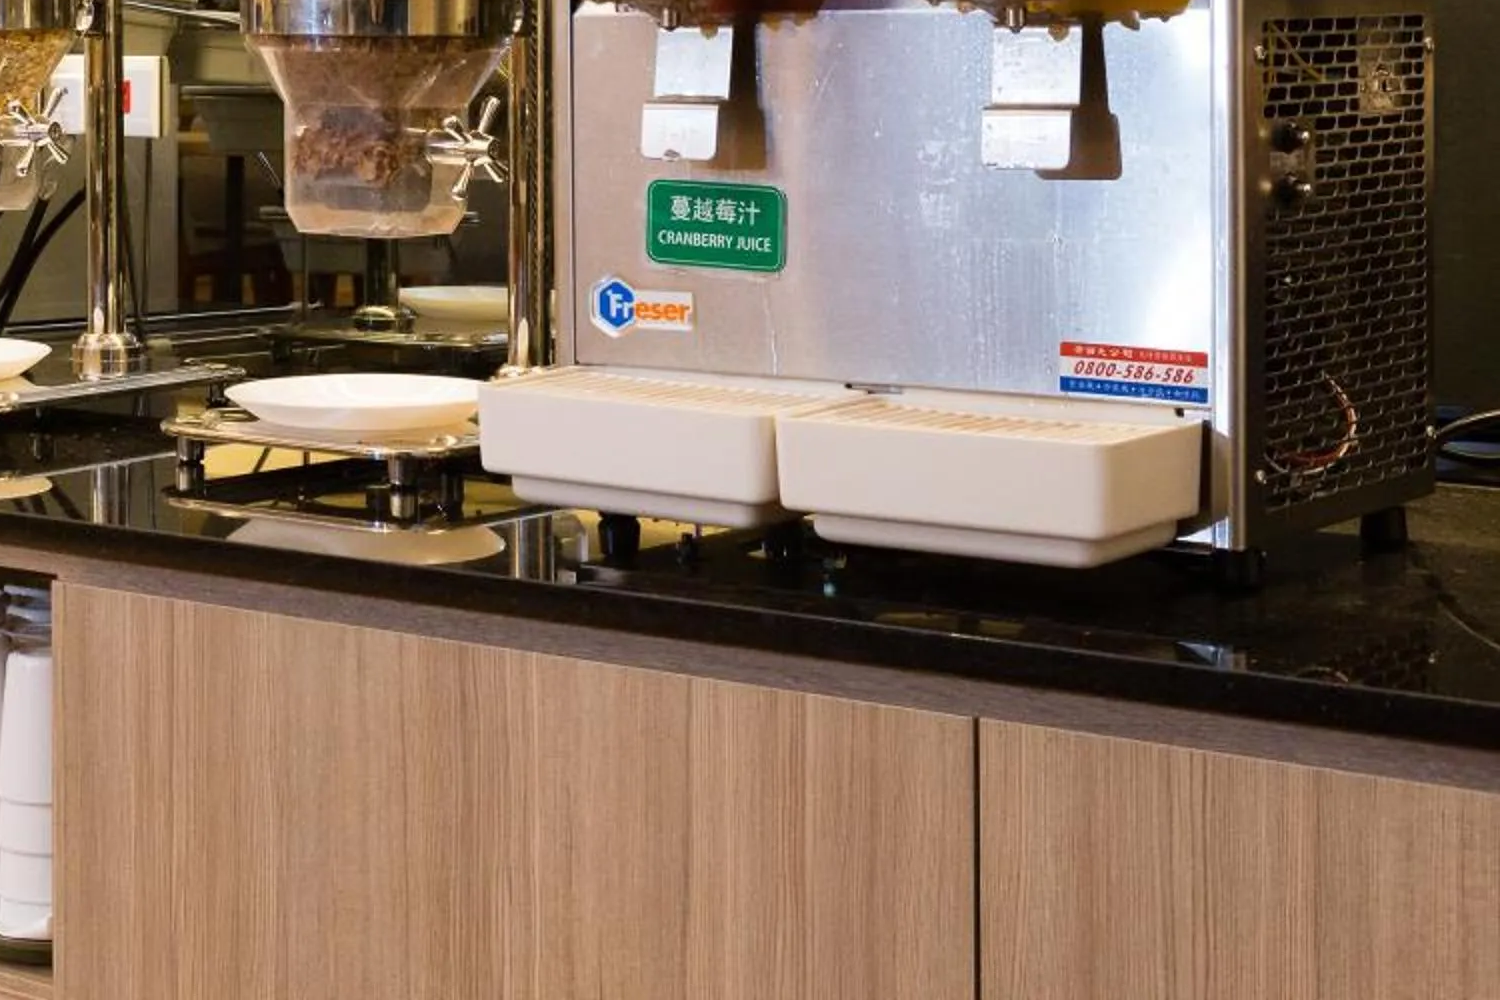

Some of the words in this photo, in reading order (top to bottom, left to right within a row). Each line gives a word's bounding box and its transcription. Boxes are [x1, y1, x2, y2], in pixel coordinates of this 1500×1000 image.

[670, 195, 761, 225] 蔓越莓汁
[657, 229, 733, 248] CRANBERRY
[736, 236, 773, 253] JUICE
[606, 290, 690, 324] Freser
[1073, 359, 1195, 384] 0800-586-586
